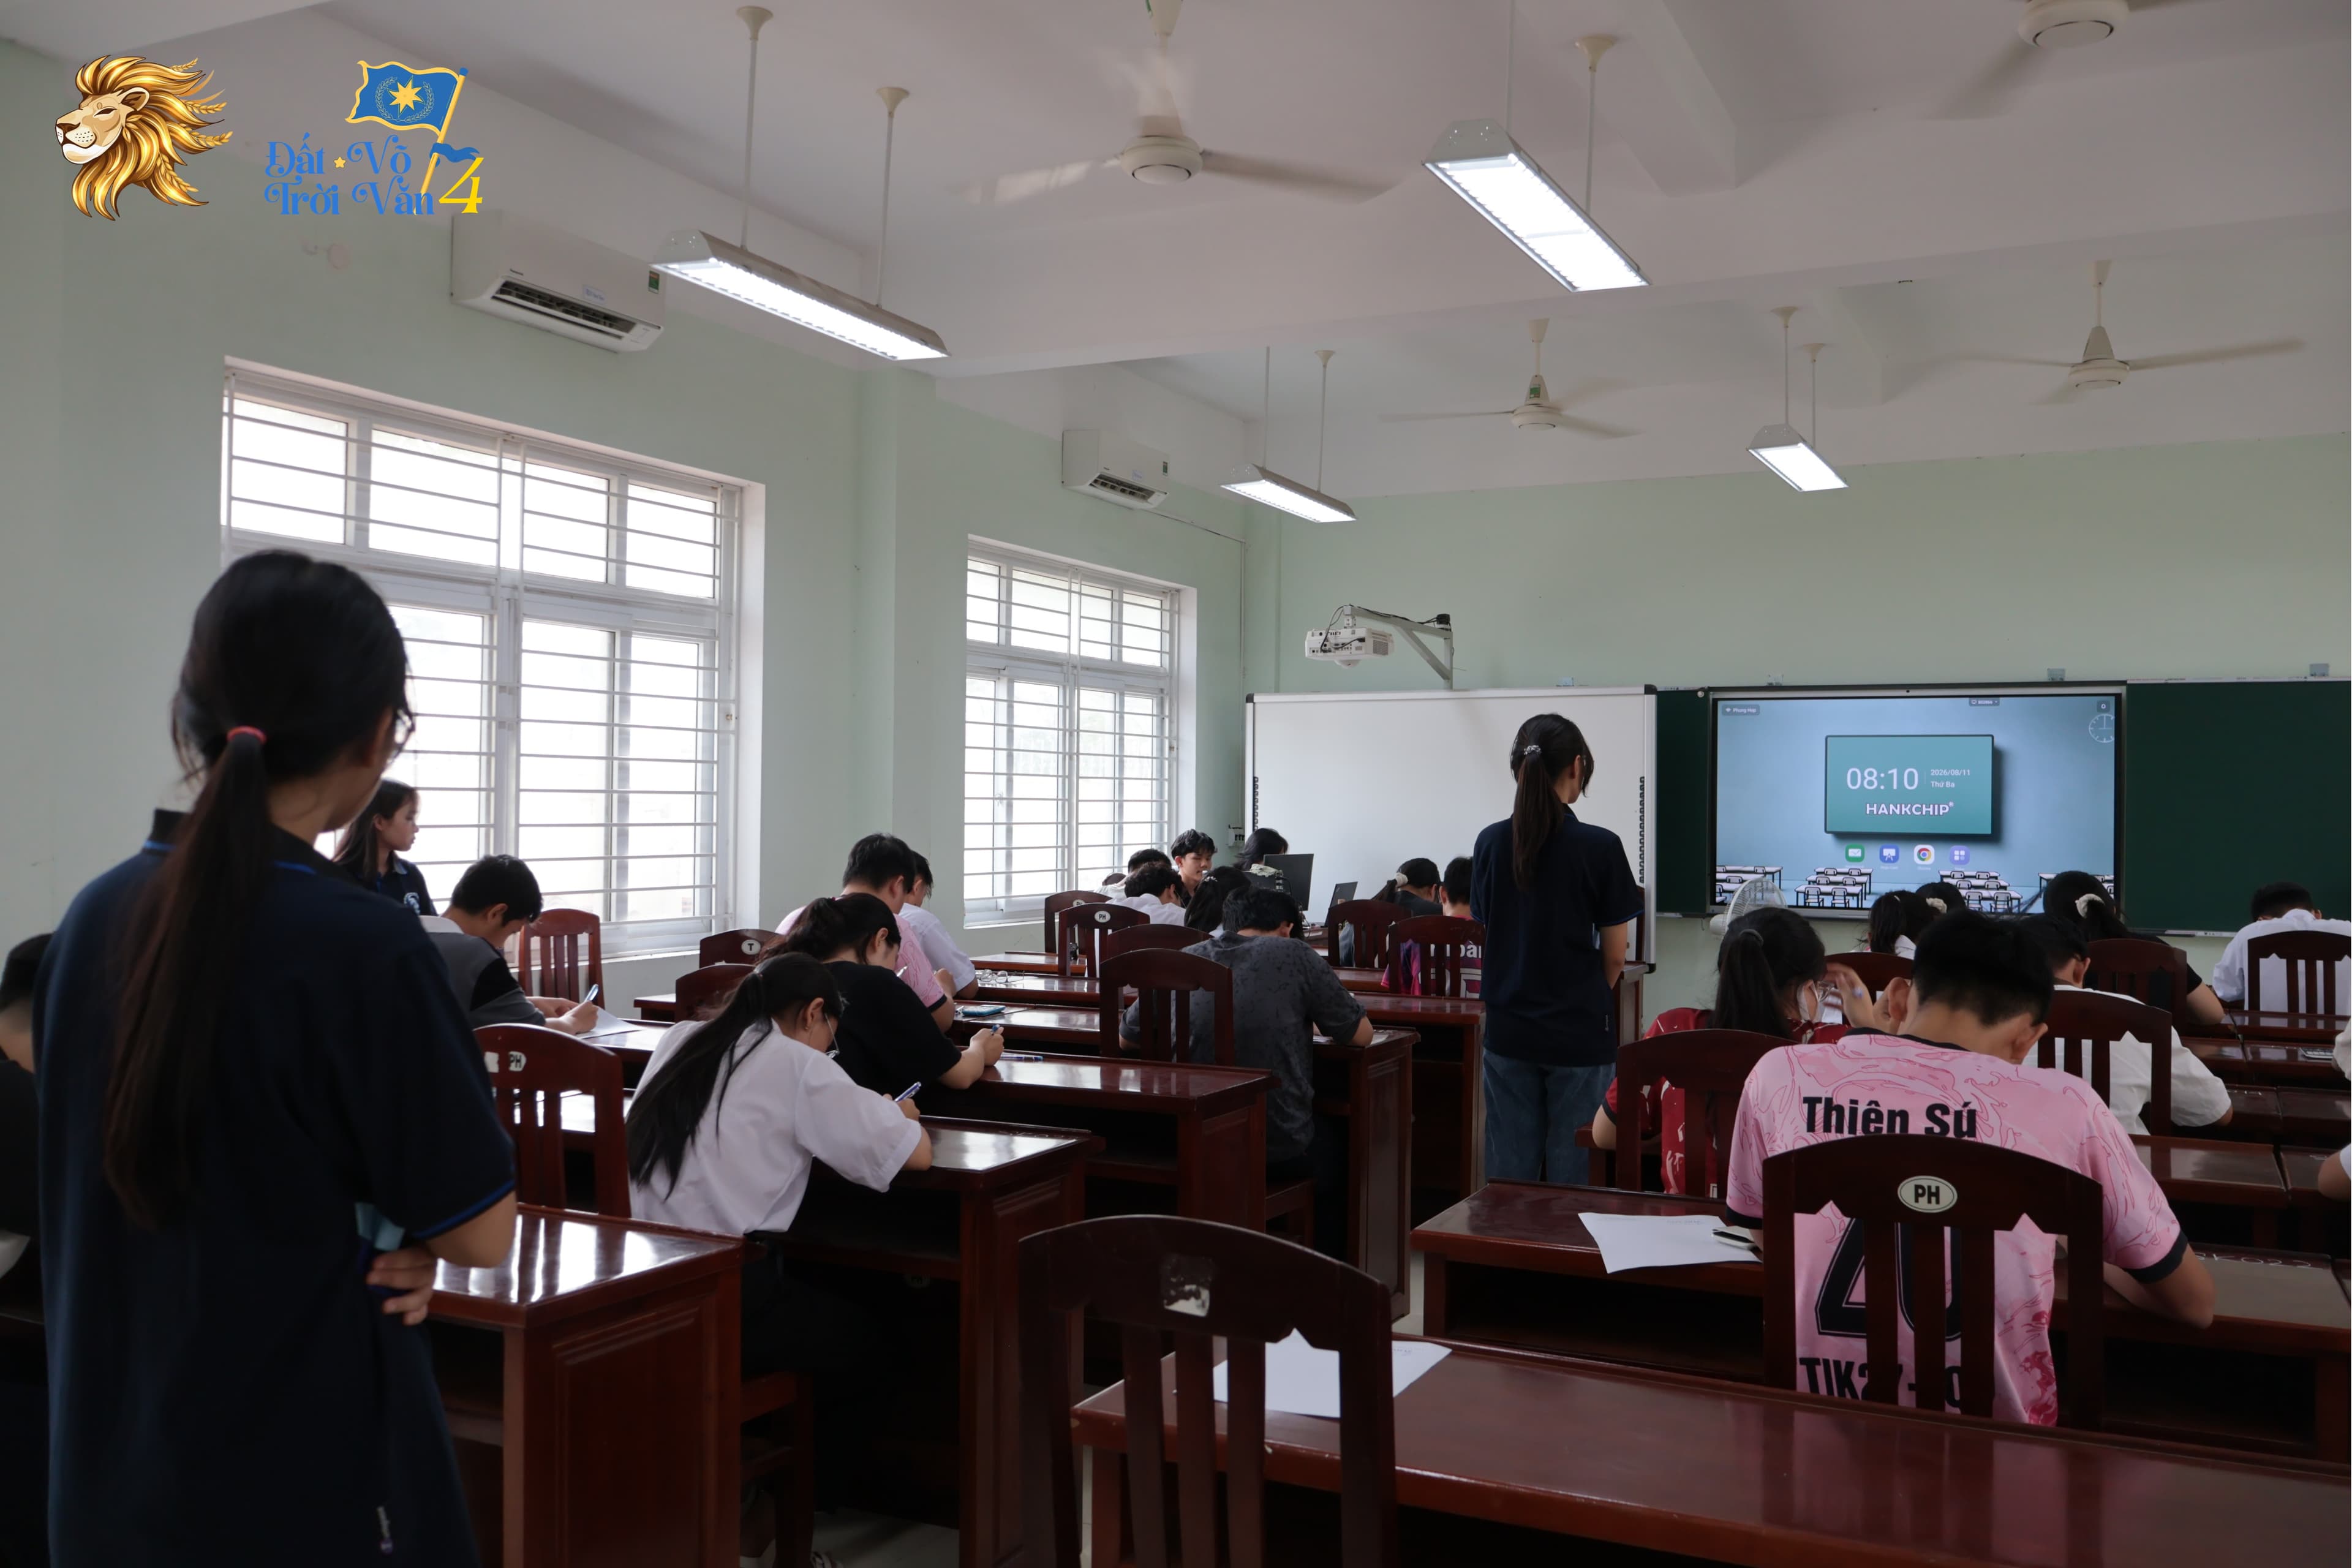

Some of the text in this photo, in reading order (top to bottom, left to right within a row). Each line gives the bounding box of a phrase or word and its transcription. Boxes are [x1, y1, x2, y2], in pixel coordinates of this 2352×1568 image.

[1847, 767, 1918, 790] 08:10
[1803, 1096, 1977, 1138] Thiên Sú
[1914, 1184, 1940, 1205] PH
